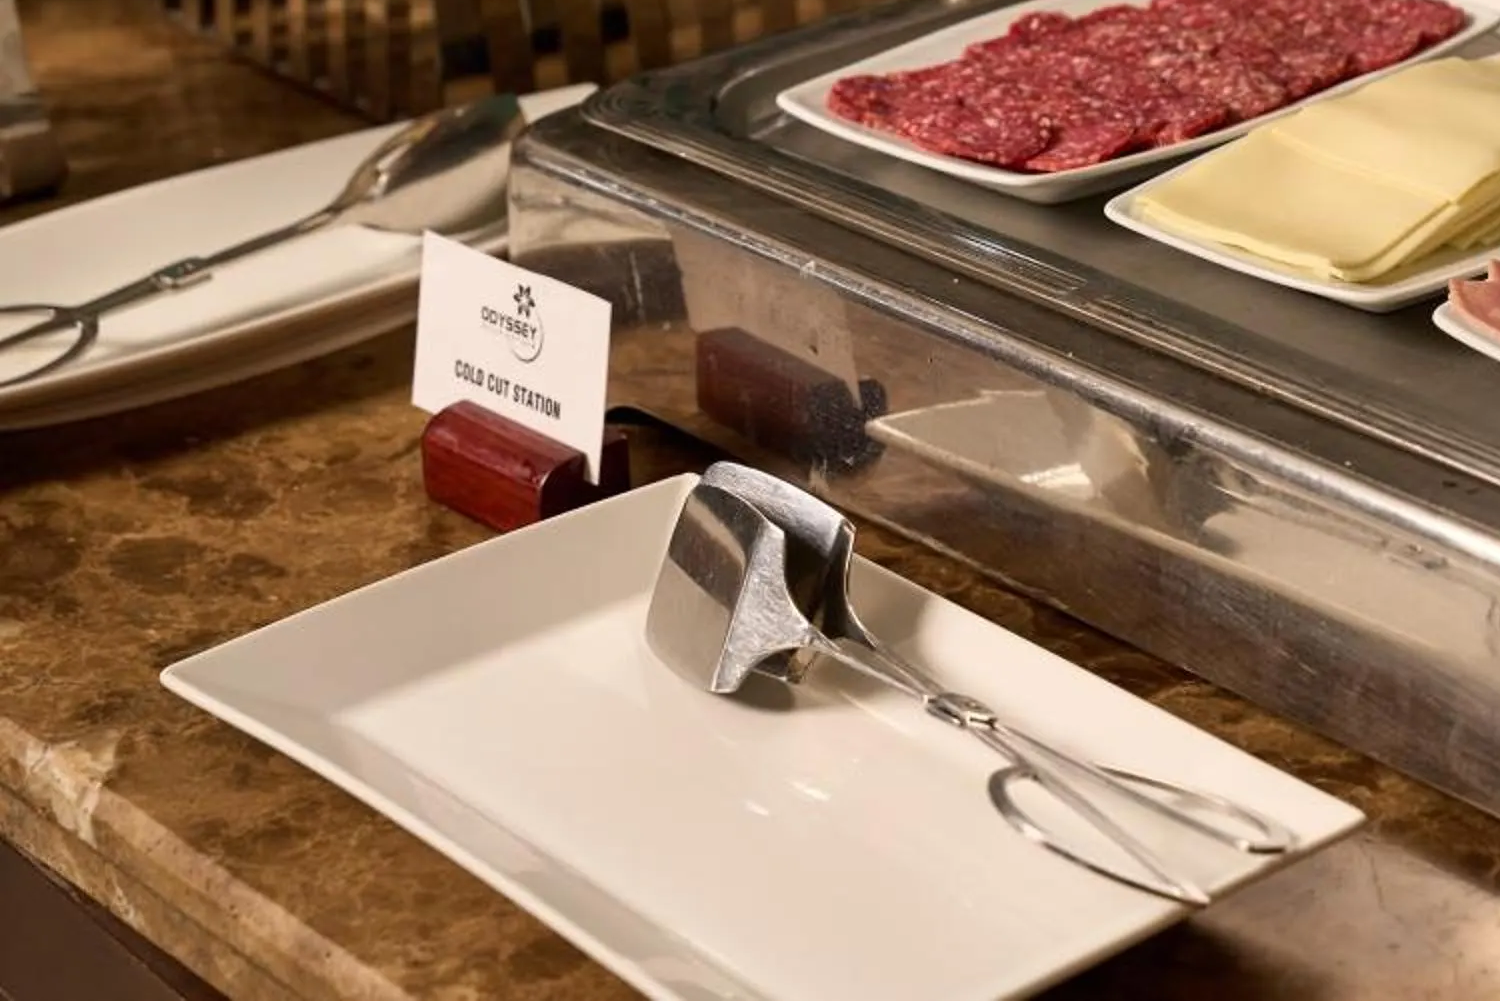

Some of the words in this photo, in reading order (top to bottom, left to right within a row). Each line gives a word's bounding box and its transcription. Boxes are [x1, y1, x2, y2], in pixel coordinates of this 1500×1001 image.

[454, 359, 485, 386] COLD
[487, 372, 510, 397] CUT
[513, 384, 562, 420] STATION
